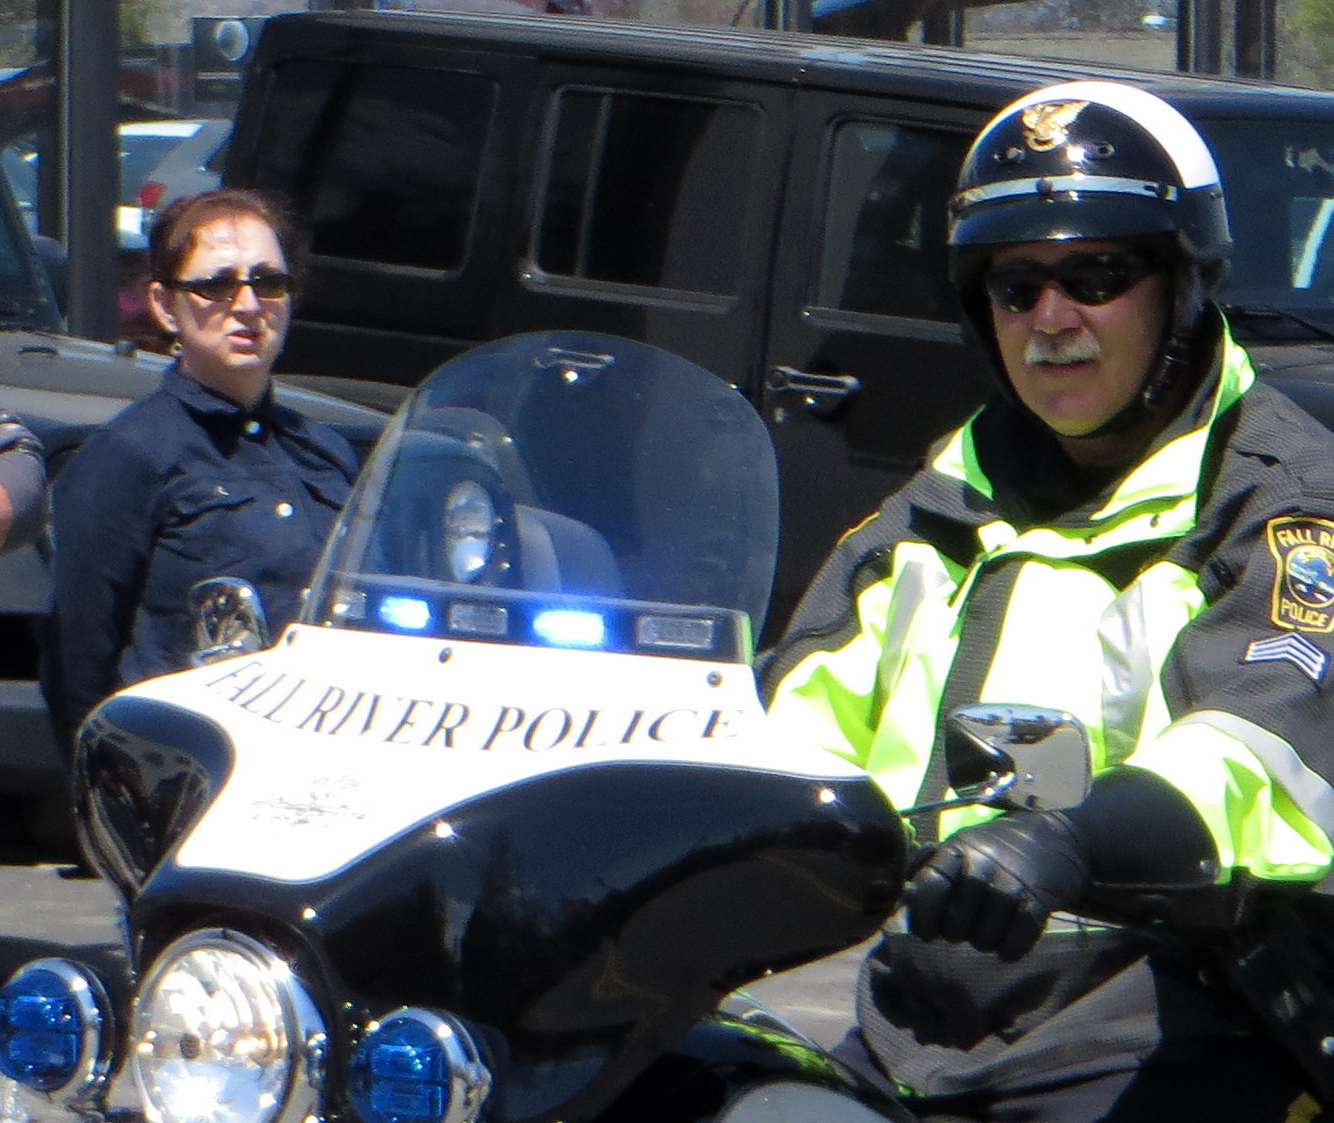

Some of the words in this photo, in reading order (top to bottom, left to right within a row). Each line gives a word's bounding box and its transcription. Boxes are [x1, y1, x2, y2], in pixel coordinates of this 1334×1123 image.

[1277, 528, 1317, 547] FALL
[1281, 597, 1329, 627] POLICE
[205, 661, 307, 724] FALL
[295, 686, 471, 748] RIVER
[479, 705, 744, 753] POLICE
